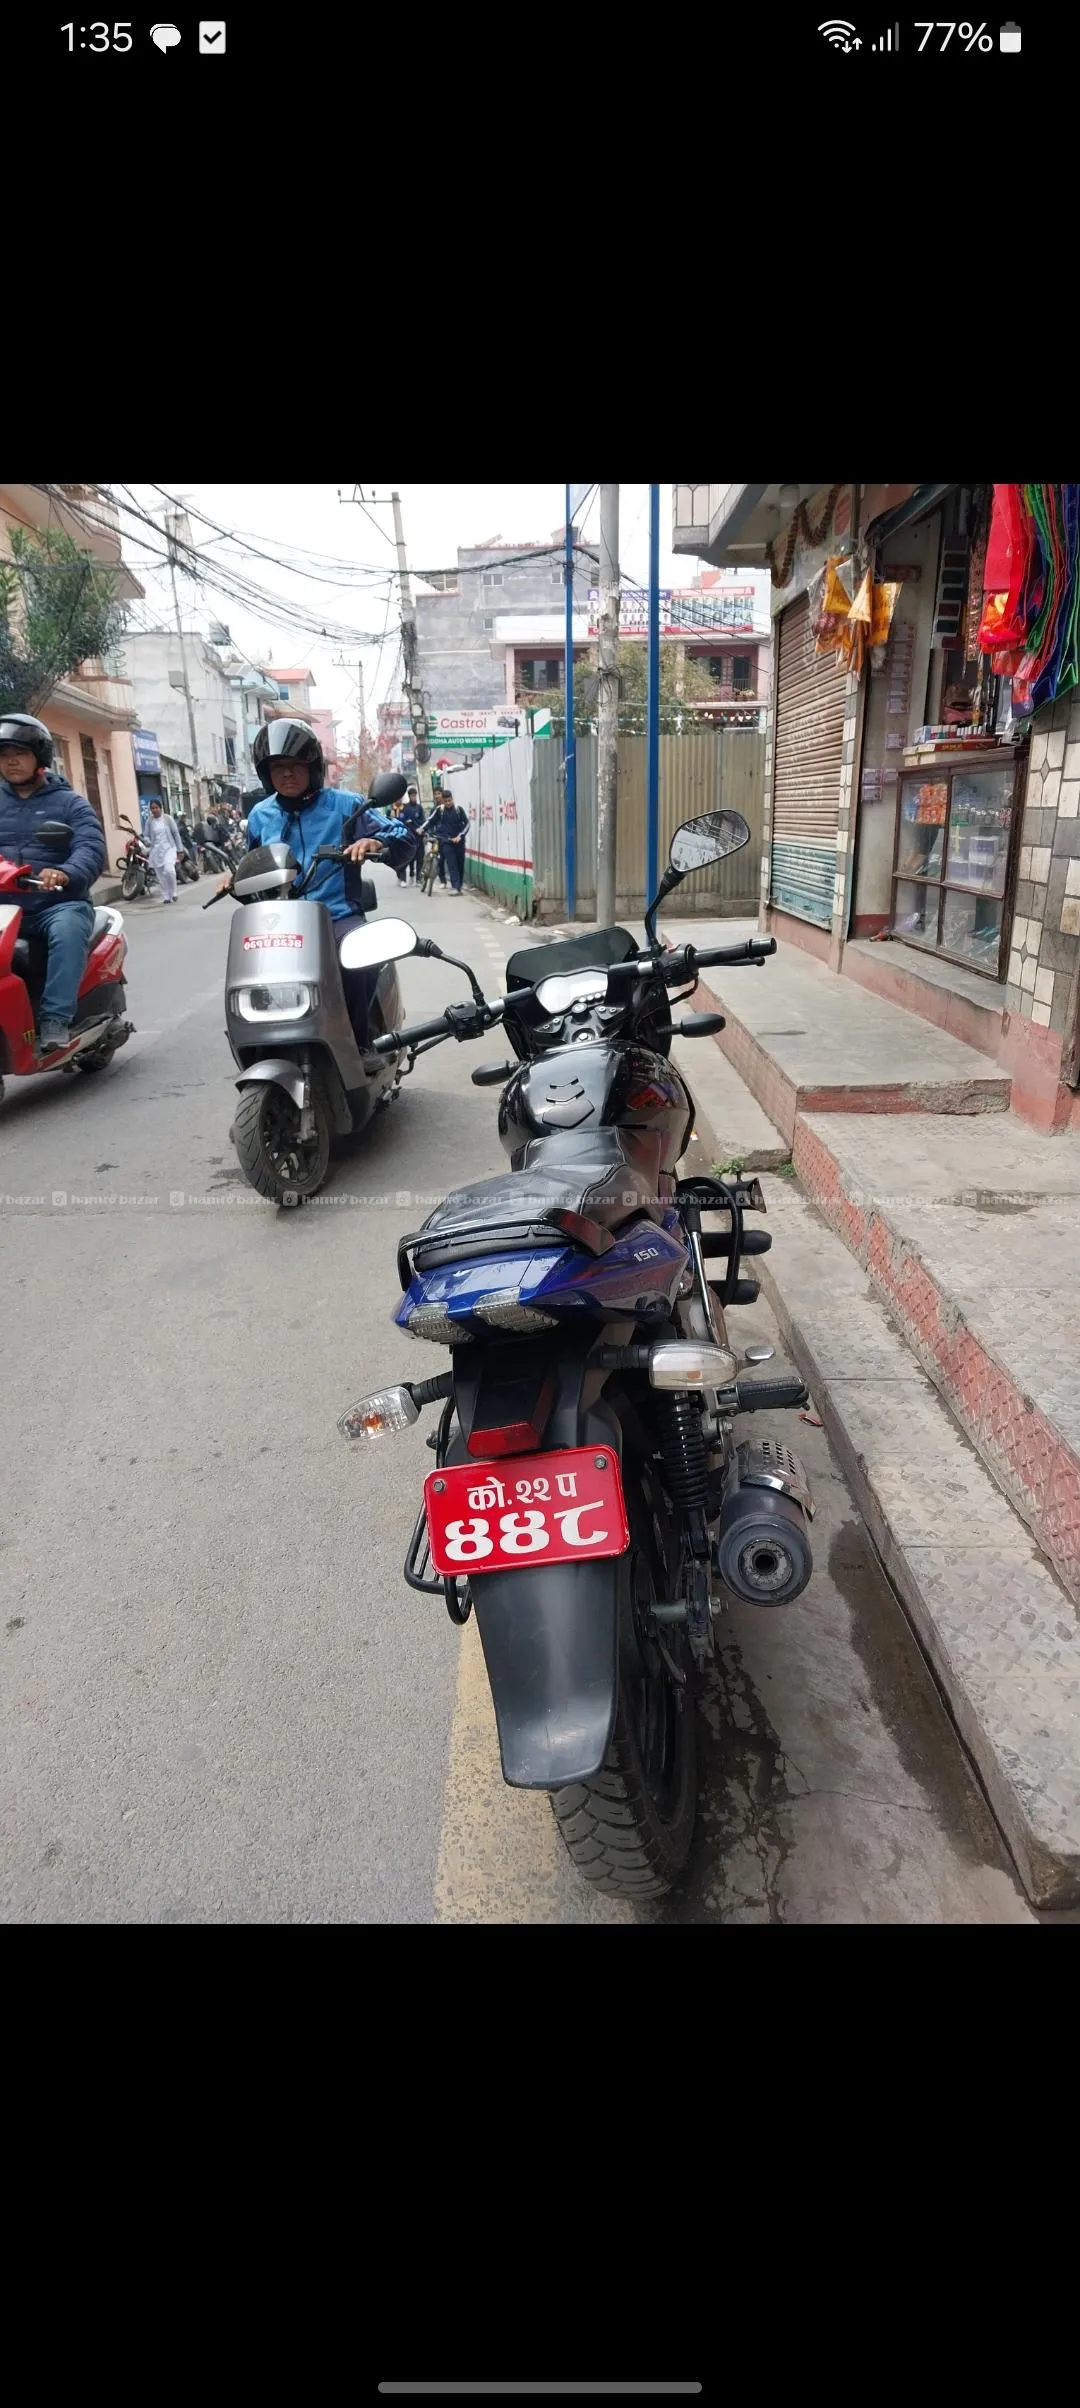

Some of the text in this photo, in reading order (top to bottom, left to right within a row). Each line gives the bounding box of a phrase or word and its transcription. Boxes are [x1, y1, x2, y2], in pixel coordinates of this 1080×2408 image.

[440, 718, 487, 729] Castrol
[633, 1247, 659, 1262] 150
[444, 1500, 609, 1561] ४४८
